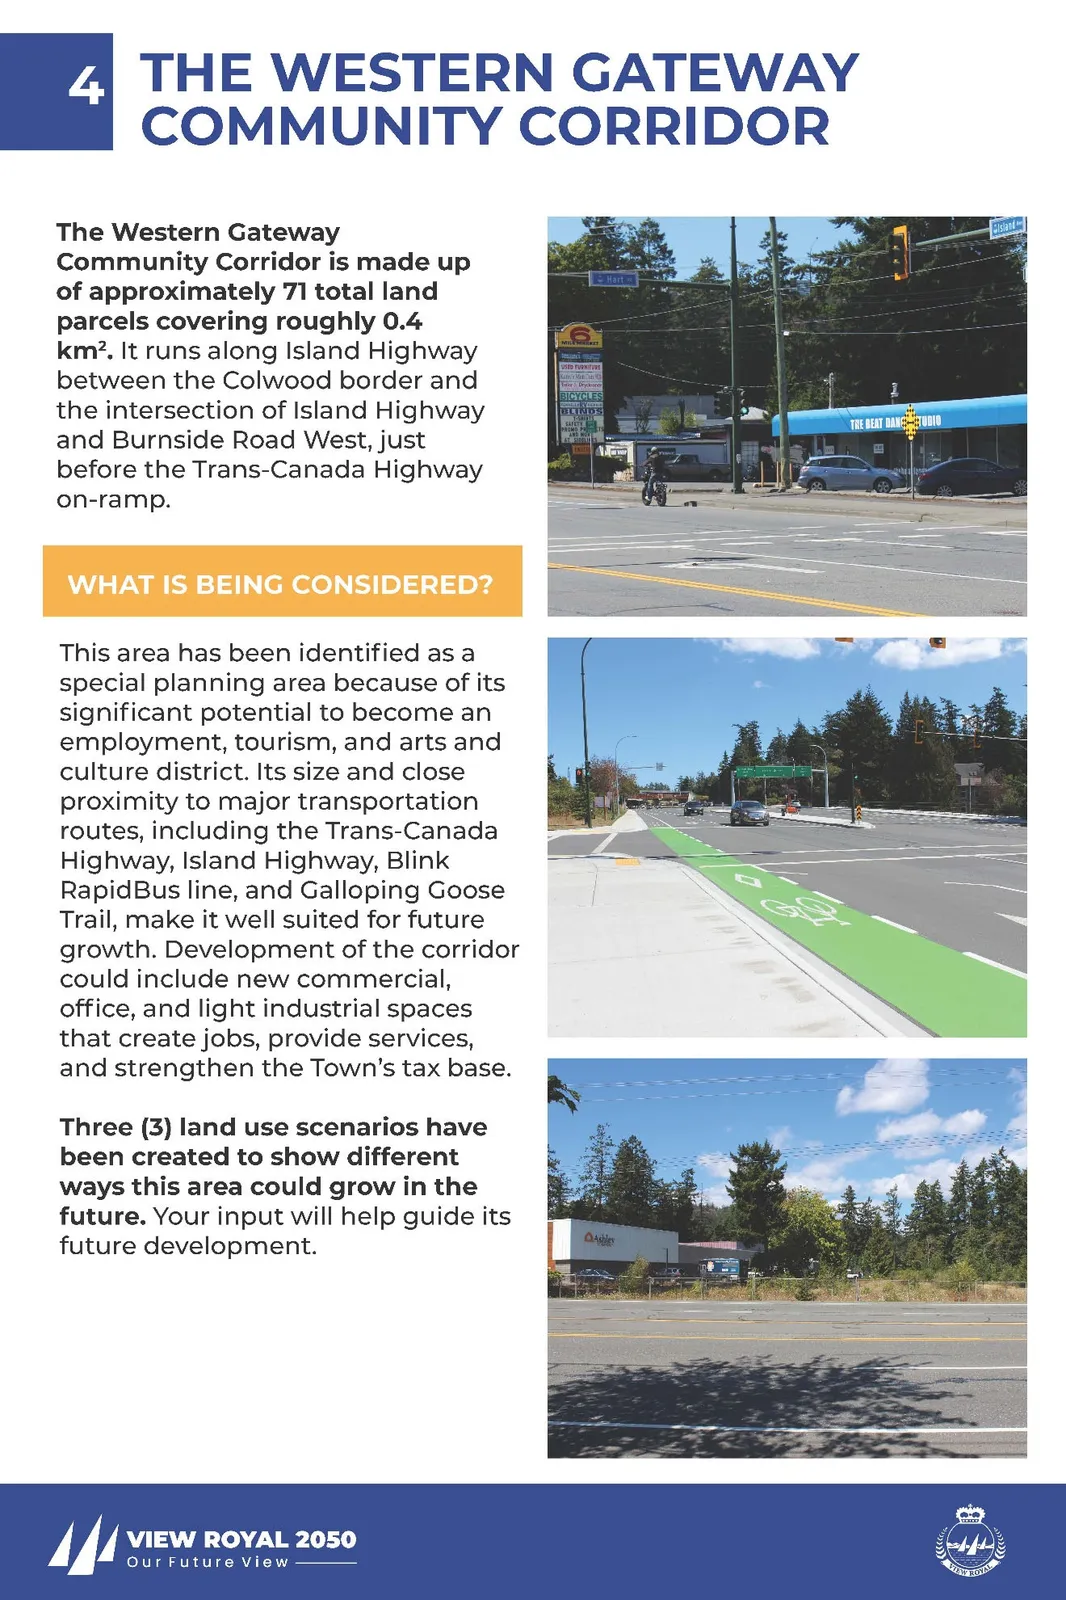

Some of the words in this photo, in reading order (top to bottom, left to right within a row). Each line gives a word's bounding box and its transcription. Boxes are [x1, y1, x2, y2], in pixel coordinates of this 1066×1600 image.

[140, 53, 251, 91] THE
[270, 52, 551, 92] WESTERN
[573, 53, 859, 92] GATEWAY
[69, 66, 104, 104] 4
[142, 106, 503, 145] COMMUNITY
[520, 106, 829, 145] CORRIDOR
[56, 222, 103, 241] The
[111, 223, 219, 241] Western
[228, 223, 340, 246] Gateway
[997, 219, 1016, 233] Island
[57, 251, 208, 276] Community
[216, 251, 321, 271] Corridor
[330, 251, 349, 271] is
[358, 252, 430, 271] made
[438, 257, 470, 275] up
[606, 275, 624, 283] Hart
[57, 281, 82, 300] of
[90, 280, 275, 305] approximately
[283, 282, 305, 300] 71
[315, 281, 373, 300] total
[384, 281, 437, 300] land
[58, 311, 149, 335] parcels
[157, 310, 267, 335] covering
[277, 311, 376, 335] roughly
[384, 312, 422, 330] 0.4
[570, 326, 591, 342] 6
[58, 341, 112, 360] km².
[123, 342, 138, 360] It
[147, 346, 200, 360] runs
[208, 341, 276, 365] along
[287, 341, 359, 360] Island
[370, 340, 477, 365] Highway
[58, 370, 165, 389] between
[173, 370, 215, 389] the
[224, 370, 330, 389] Colwood
[341, 370, 422, 389] border
[431, 370, 476, 389] and
[560, 392, 603, 401] BICYCLES
[56, 400, 97, 419] the
[107, 400, 253, 419] intersection
[262, 400, 287, 419] of
[295, 400, 366, 419] Island
[377, 400, 485, 424] Highway
[850, 419, 864, 430] THE
[865, 417, 883, 429] BEAT
[917, 414, 942, 427] TUDIO
[57, 430, 103, 449] and
[114, 430, 224, 449] Burnside
[234, 430, 294, 449] Road
[304, 431, 372, 452] West,
[378, 430, 425, 453] just
[58, 459, 136, 478] before
[144, 460, 185, 478] the
[192, 460, 364, 478] Trans-Canada
[375, 459, 483, 483] Highway
[57, 494, 170, 512] on-ramp.
[68, 575, 154, 594] WHAT
[164, 575, 187, 594] IS
[197, 575, 282, 594] BEING
[292, 575, 493, 594] CONSIDERED?
[60, 643, 110, 662] This
[118, 648, 169, 662] area
[180, 643, 221, 662] has
[230, 643, 290, 662] been
[300, 642, 418, 662] identified
[428, 648, 454, 662] as
[462, 648, 474, 662] a
[60, 702, 192, 726] significant
[202, 702, 310, 726] potential
[320, 705, 343, 721] to
[353, 702, 453, 721] become
[462, 707, 490, 721] an
[60, 762, 148, 781] culture
[157, 761, 248, 781] district.
[258, 763, 286, 780] Its
[294, 761, 339, 780] size
[347, 762, 393, 780] and
[403, 762, 464, 780] close
[62, 823, 143, 843] routes,
[153, 820, 267, 845] including
[277, 821, 318, 840] the
[325, 821, 497, 840] Trans-Canada
[62, 850, 174, 874] Highway,
[184, 851, 255, 869] Island
[266, 850, 378, 874] Highway,
[388, 850, 449, 869] Blink
[60, 940, 156, 963] growth.
[166, 940, 334, 963] Development
[342, 939, 367, 958] of
[373, 940, 414, 958] the
[422, 939, 519, 958] corridor
[60, 998, 135, 1021] office,
[144, 999, 189, 1017] and
[200, 998, 255, 1022] light
[264, 998, 379, 1018] industrial
[388, 1003, 472, 1022] spaces
[60, 1058, 106, 1077] and
[115, 1058, 253, 1081] strengthen
[262, 1058, 303, 1076] the
[310, 1058, 395, 1076] Town’s
[402, 1060, 440, 1077] tax
[449, 1058, 510, 1076] base.
[60, 1117, 133, 1136] Three
[142, 1117, 171, 1140] (3)
[181, 1117, 235, 1136] land
[245, 1122, 288, 1136] use
[296, 1116, 418, 1136] scenarios
[427, 1117, 487, 1136] have
[60, 1181, 124, 1200] ways
[132, 1176, 180, 1195] this
[188, 1181, 242, 1195] area
[251, 1176, 321, 1195] could
[329, 1181, 396, 1200] grow
[404, 1176, 426, 1195] in
[434, 1177, 477, 1195] the
[60, 1206, 145, 1225] future.
[153, 1207, 209, 1225] Your
[219, 1206, 284, 1230] input
[291, 1206, 331, 1225] will
[342, 1206, 395, 1230] help
[404, 1206, 474, 1230] guide
[484, 1206, 510, 1225] its
[60, 1235, 136, 1254] future
[144, 1236, 316, 1259] development.
[127, 1531, 196, 1548] VIEW
[205, 1531, 289, 1548] ROYAL
[295, 1531, 356, 1548] 2050
[127, 1556, 161, 1567] Our
[170, 1557, 233, 1567] Future
[242, 1556, 288, 1567] View
[949, 1563, 968, 1576] VIEW
[969, 1563, 993, 1576] ROYAL
